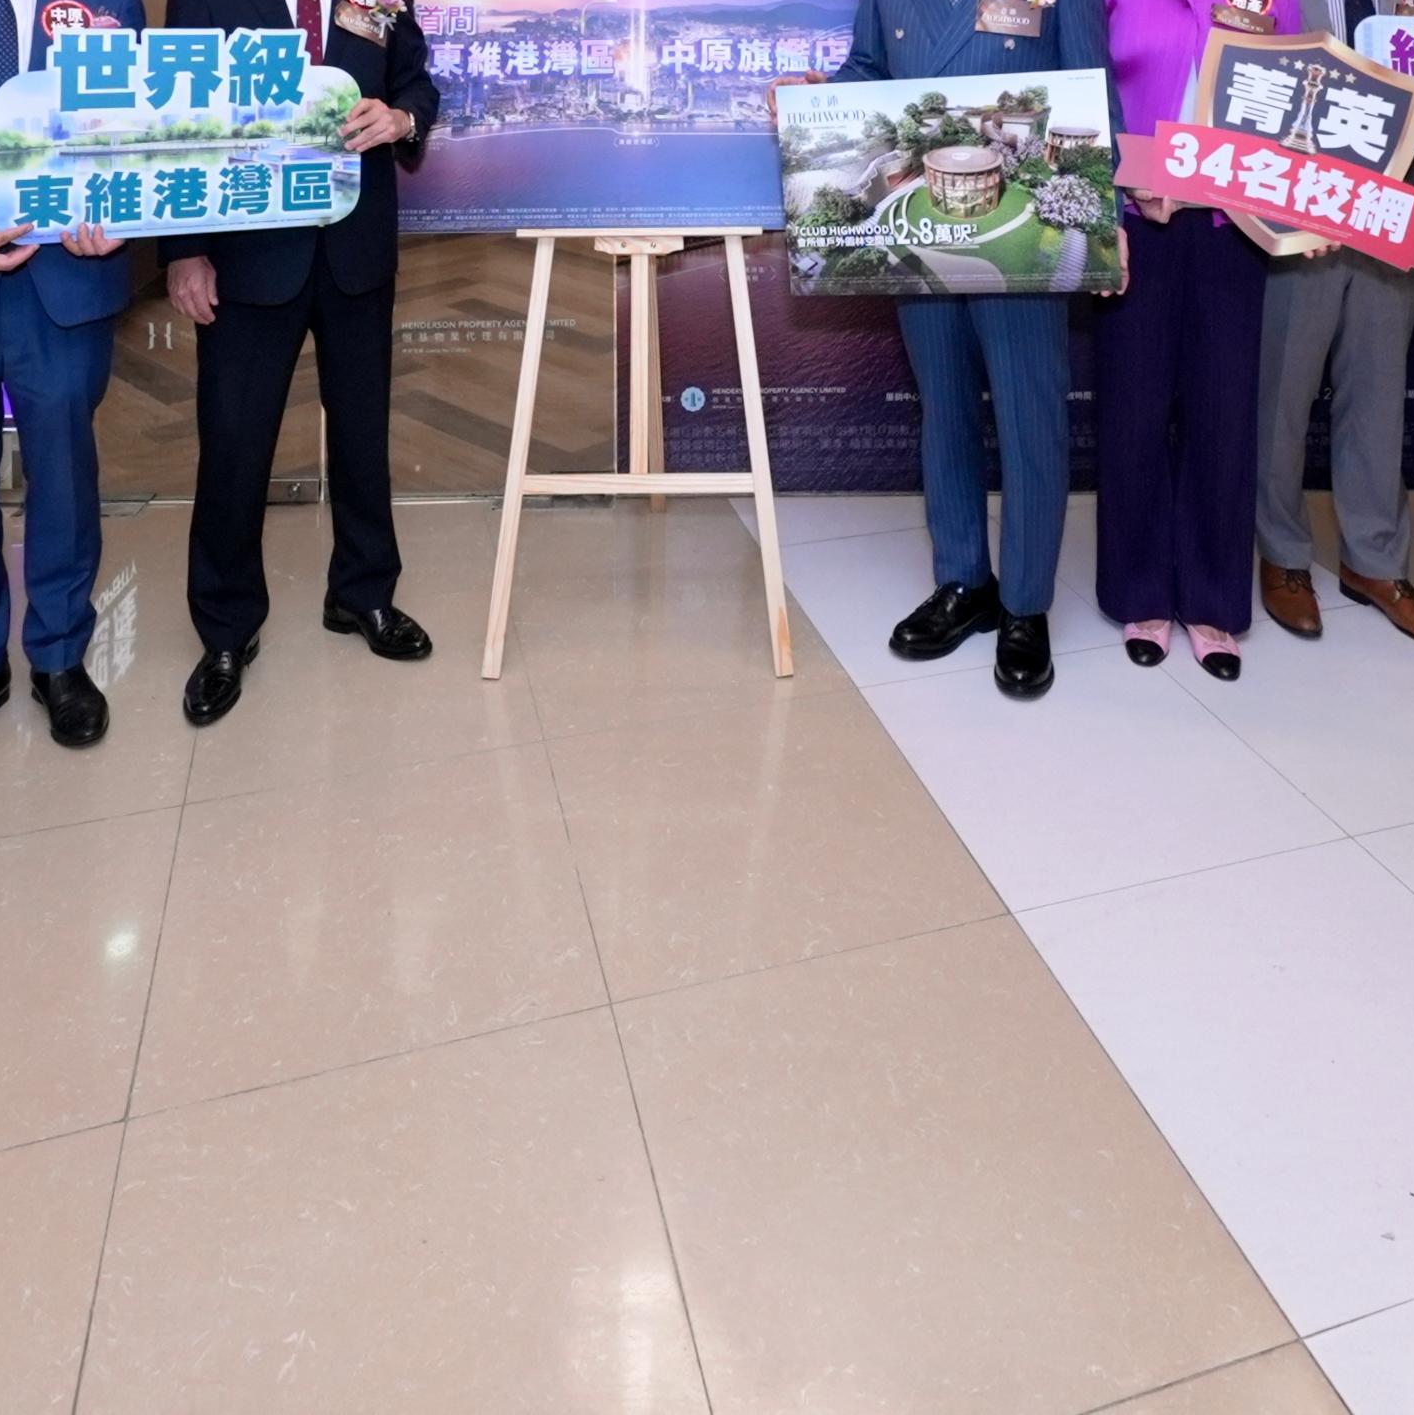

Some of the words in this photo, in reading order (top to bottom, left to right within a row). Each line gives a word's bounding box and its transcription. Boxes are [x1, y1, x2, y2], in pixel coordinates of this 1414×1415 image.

[50, 7, 84, 23] 中原
[416, 4, 477, 35] 首間
[53, 32, 307, 113] 世界級
[429, 38, 617, 77] 東維港灣區
[660, 37, 849, 75] 中原旗艦店
[787, 109, 866, 124] HIGHWOOD
[1224, 61, 1396, 163] 菁英
[14, 161, 334, 229] 東維港灣區
[504, 319, 528, 328] AGEN
[544, 319, 577, 328] IMITED
